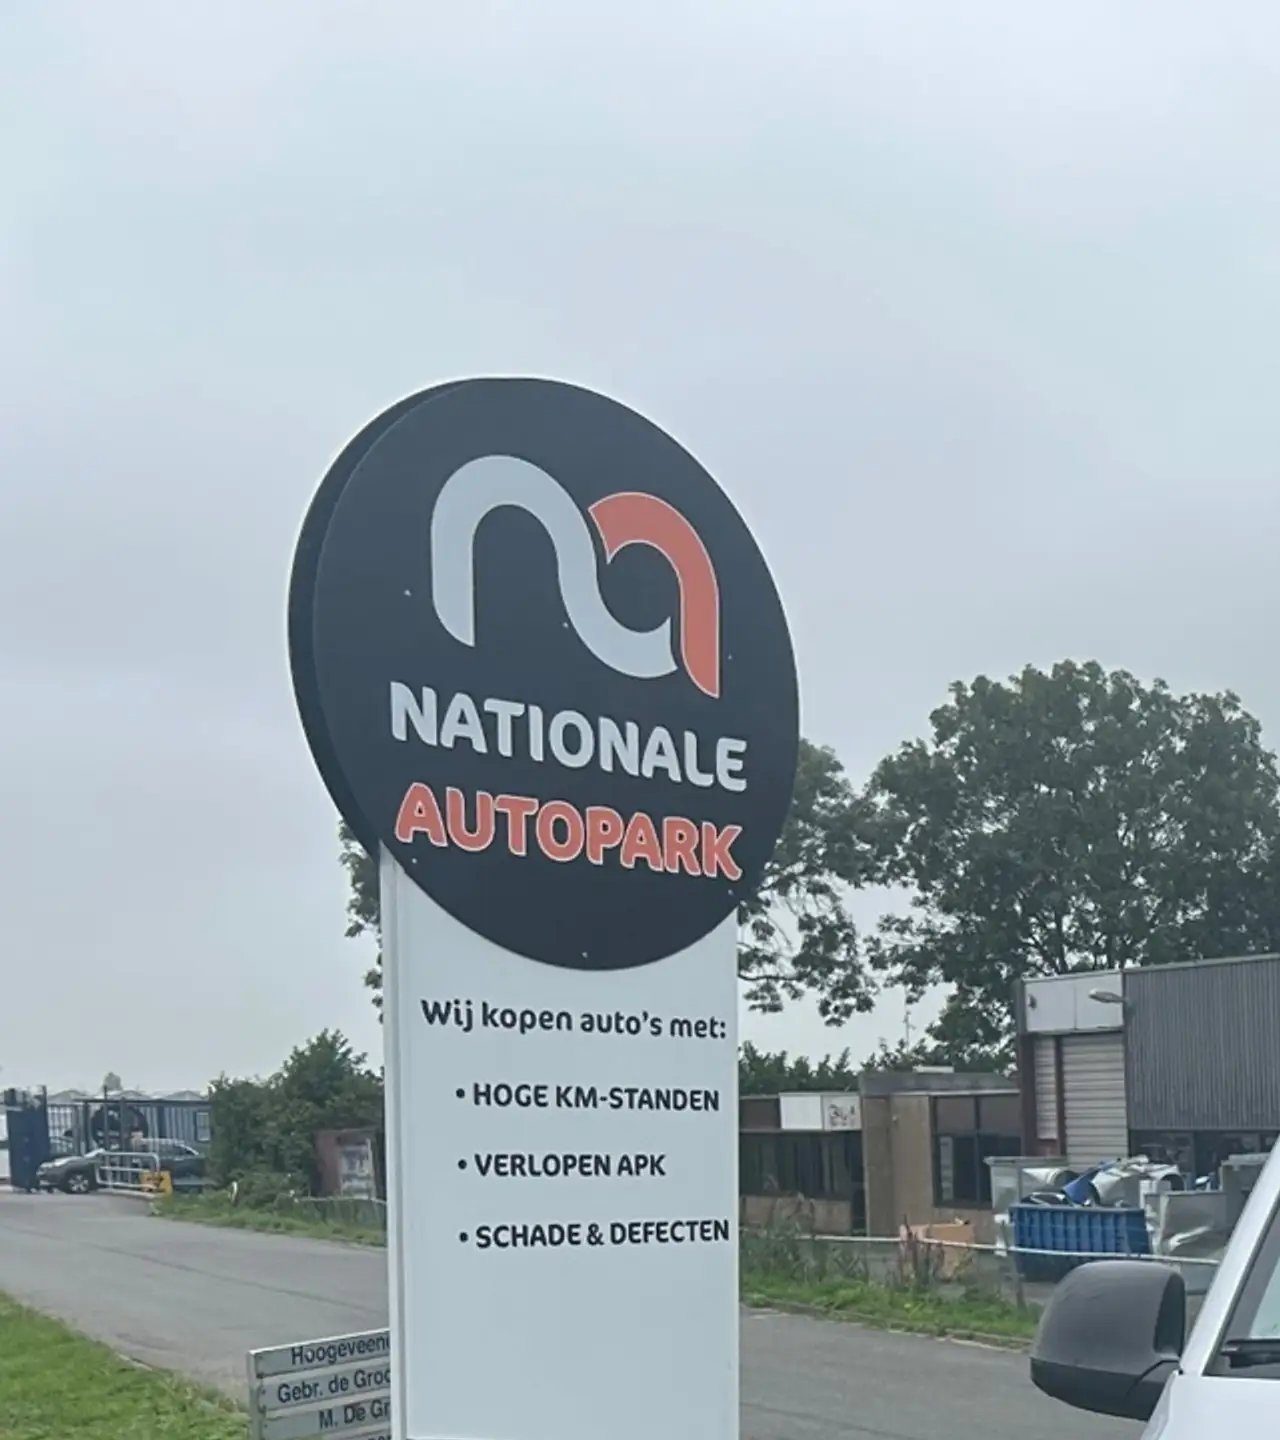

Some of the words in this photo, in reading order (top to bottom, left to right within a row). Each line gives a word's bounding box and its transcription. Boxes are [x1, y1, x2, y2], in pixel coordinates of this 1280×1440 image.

[389, 681, 748, 792] NATIONALE
[394, 782, 743, 881] AUTOPARK
[421, 999, 474, 1033] Wij
[482, 1002, 573, 1035] kopen
[580, 1011, 663, 1037] auto's
[669, 1016, 727, 1039] met:
[473, 1083, 549, 1108] HOGE
[555, 1085, 720, 1112] KM-STANDEN
[474, 1154, 611, 1177] VERLOPEN
[616, 1155, 667, 1177] APK
[475, 1224, 582, 1250] SCHADE
[586, 1223, 605, 1246] &
[609, 1219, 730, 1245] DEFECTEN
[277, 1379, 324, 1403] Gebr.
[328, 1374, 349, 1393] de
[319, 1409, 339, 1429] M.
[344, 1405, 366, 1424] De
